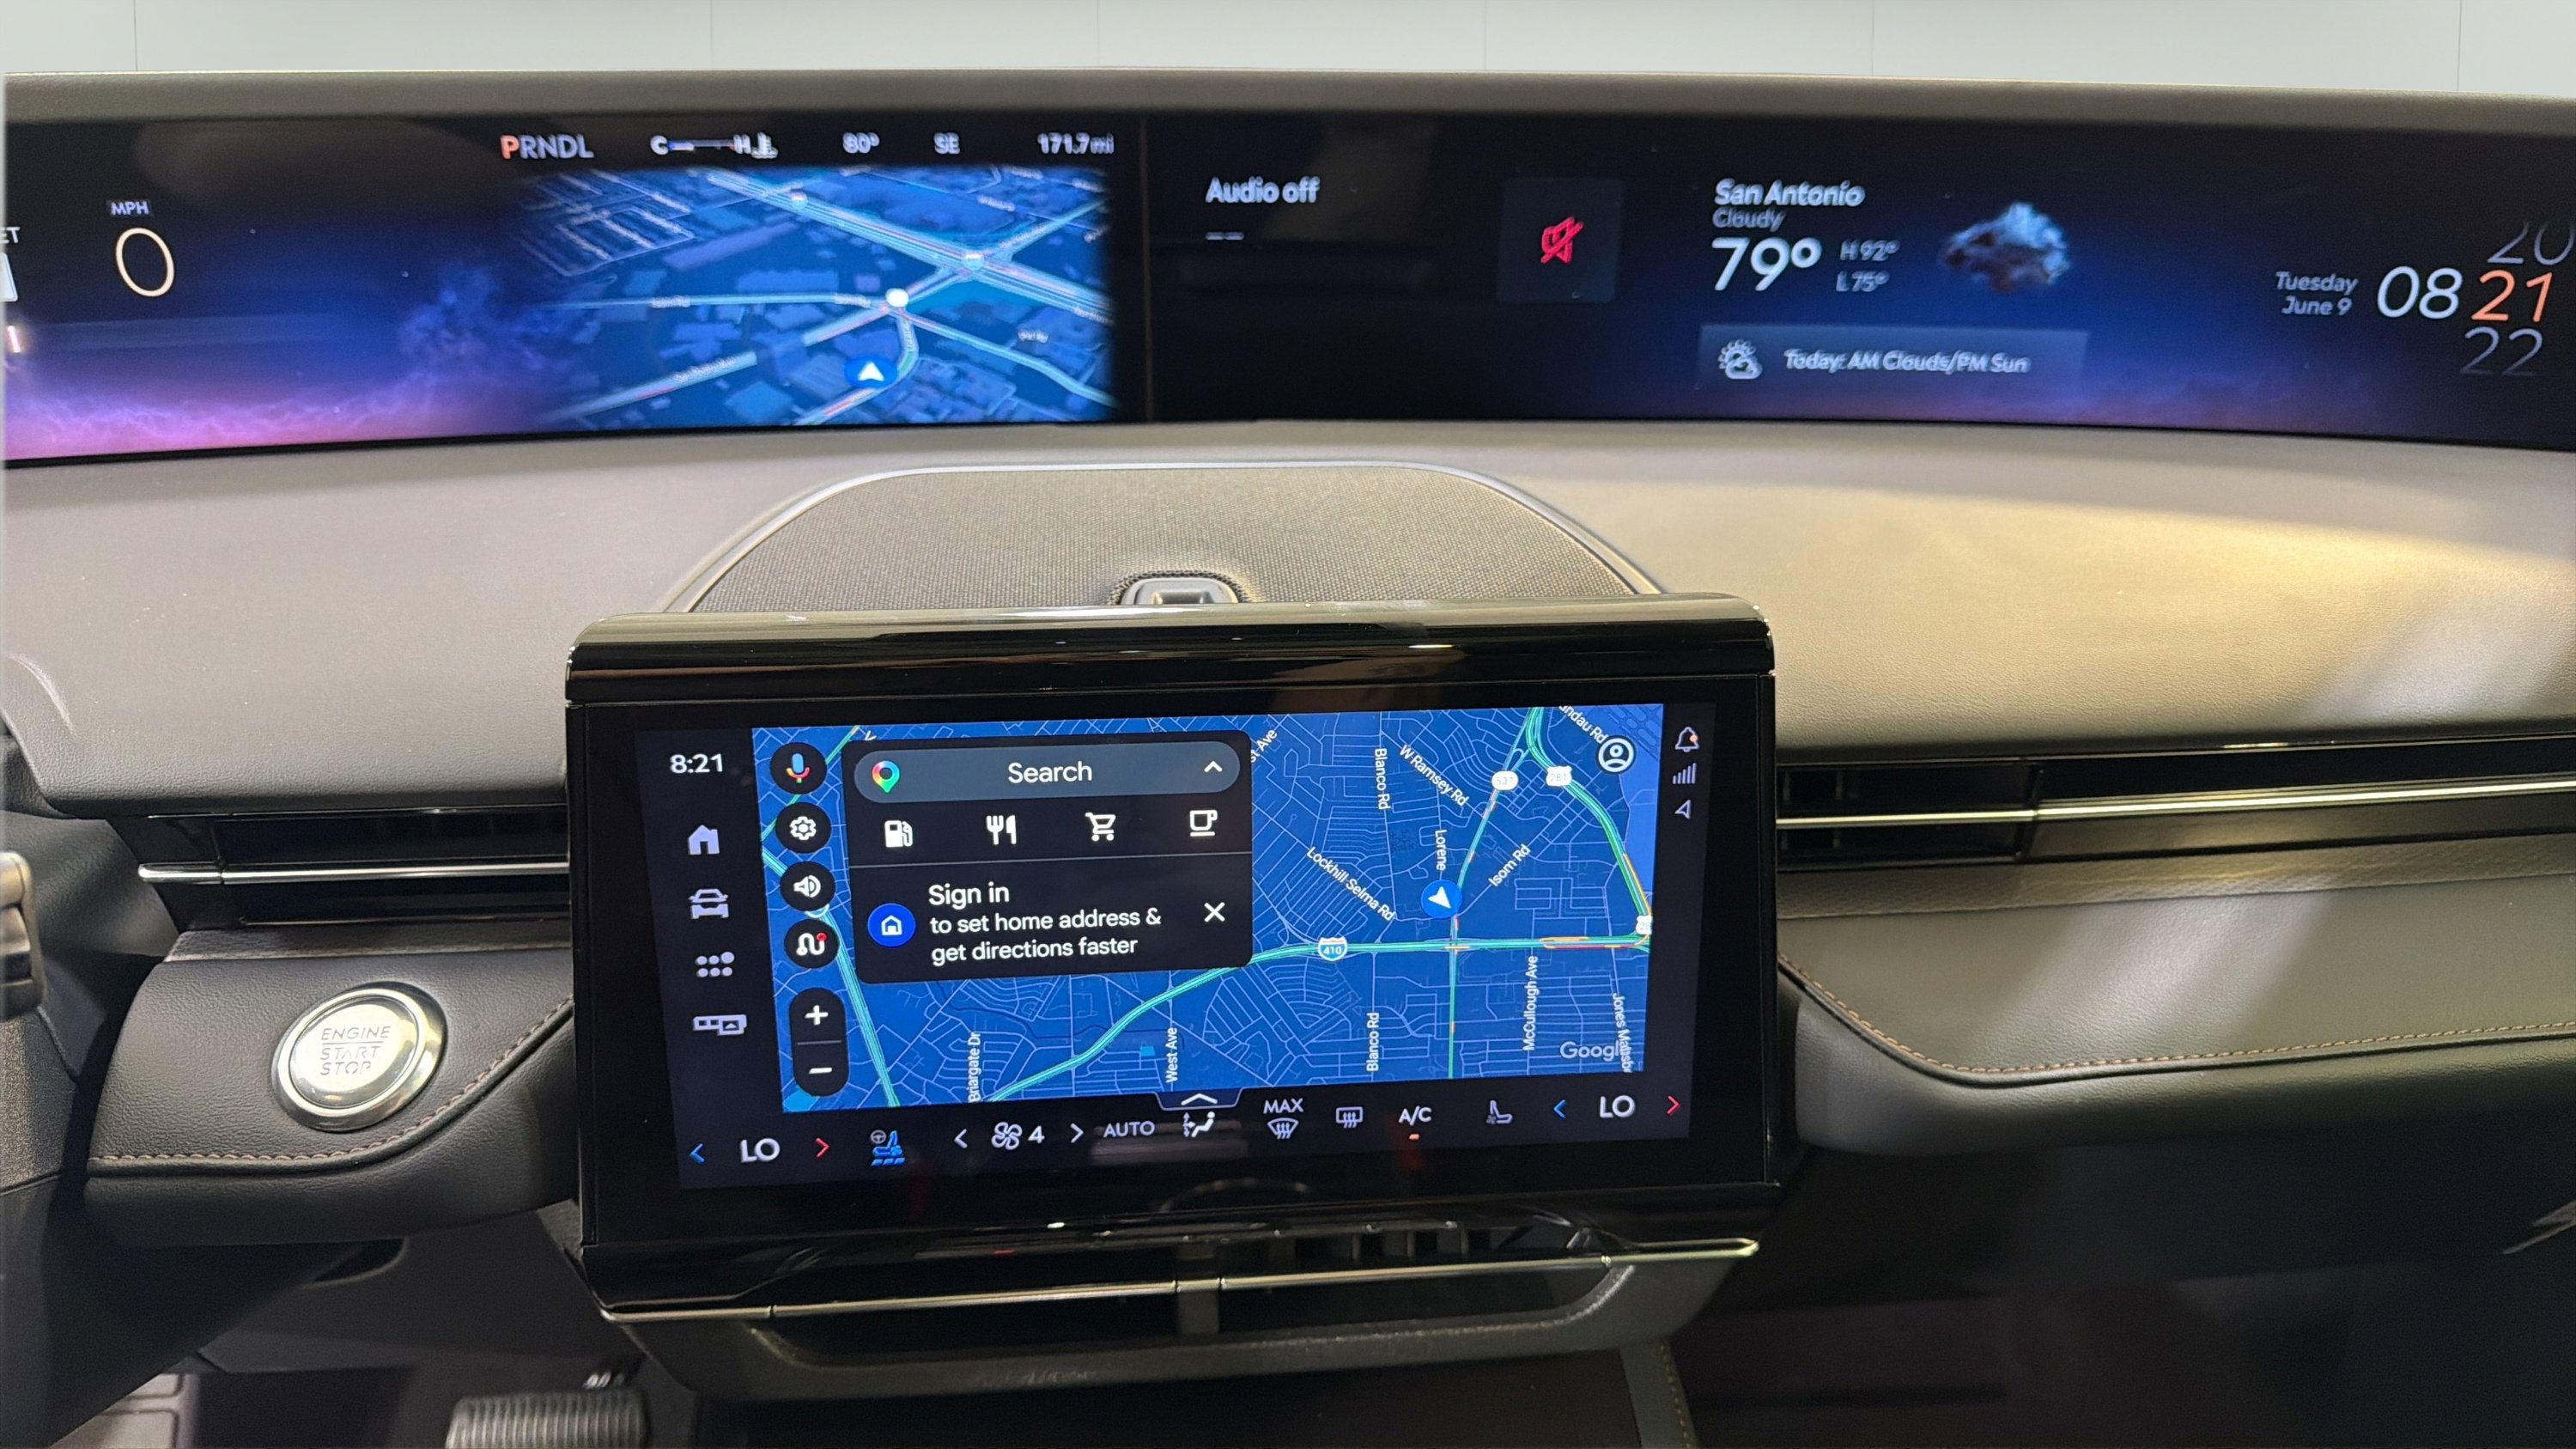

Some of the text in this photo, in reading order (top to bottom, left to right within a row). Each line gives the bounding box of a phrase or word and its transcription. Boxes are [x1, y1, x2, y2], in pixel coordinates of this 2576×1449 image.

[501, 134, 593, 159] PRNDL
[933, 132, 960, 155] SE
[1206, 176, 1321, 204] Audio off
[1715, 178, 1866, 206] San Antonio
[110, 200, 149, 216] MPH
[1712, 207, 1786, 232] Cloudy
[1840, 240, 1860, 260] H
[1836, 271, 1851, 292] L
[2275, 271, 2359, 295] Tuesday
[2377, 266, 2553, 322] 08 21
[2281, 295, 2353, 316] June 9
[1784, 348, 2031, 374] Today: AM Clouds/PM Sun
[1256, 729, 1278, 752] Ave
[1589, 726, 1609, 744] Rd
[670, 753, 723, 774] 8:21
[1007, 761, 1093, 784] Search
[1399, 744, 1469, 807] W Ramsey Rd
[1375, 747, 1391, 810] Blanco Rd
[1435, 829, 1447, 871] Lorene
[1488, 843, 1531, 887] Isom Rd
[928, 881, 1010, 910] Sign in
[1306, 846, 1397, 922] Lockhill Selma Rd
[930, 907, 1161, 934] to set home address &
[932, 936, 1139, 966] get directions faster
[1323, 946, 1342, 955] 410
[1522, 955, 1540, 1051] McCullough Ave
[1613, 993, 1625, 1028] Jones
[321, 1026, 392, 1040] ENGINE
[1366, 1012, 1379, 1072] Blanco Rd
[319, 1045, 381, 1060] START
[1165, 1027, 1177, 1083] West Ave
[319, 1061, 372, 1075] STOP
[967, 1032, 981, 1103] Briargate Dr
[1263, 1098, 1304, 1114] MAX
[1398, 1105, 1432, 1126] A/C
[1600, 1095, 1636, 1118] LO
[1027, 1125, 1045, 1144] 4
[1103, 1121, 1155, 1138] AUTO
[739, 1137, 781, 1163] LO
